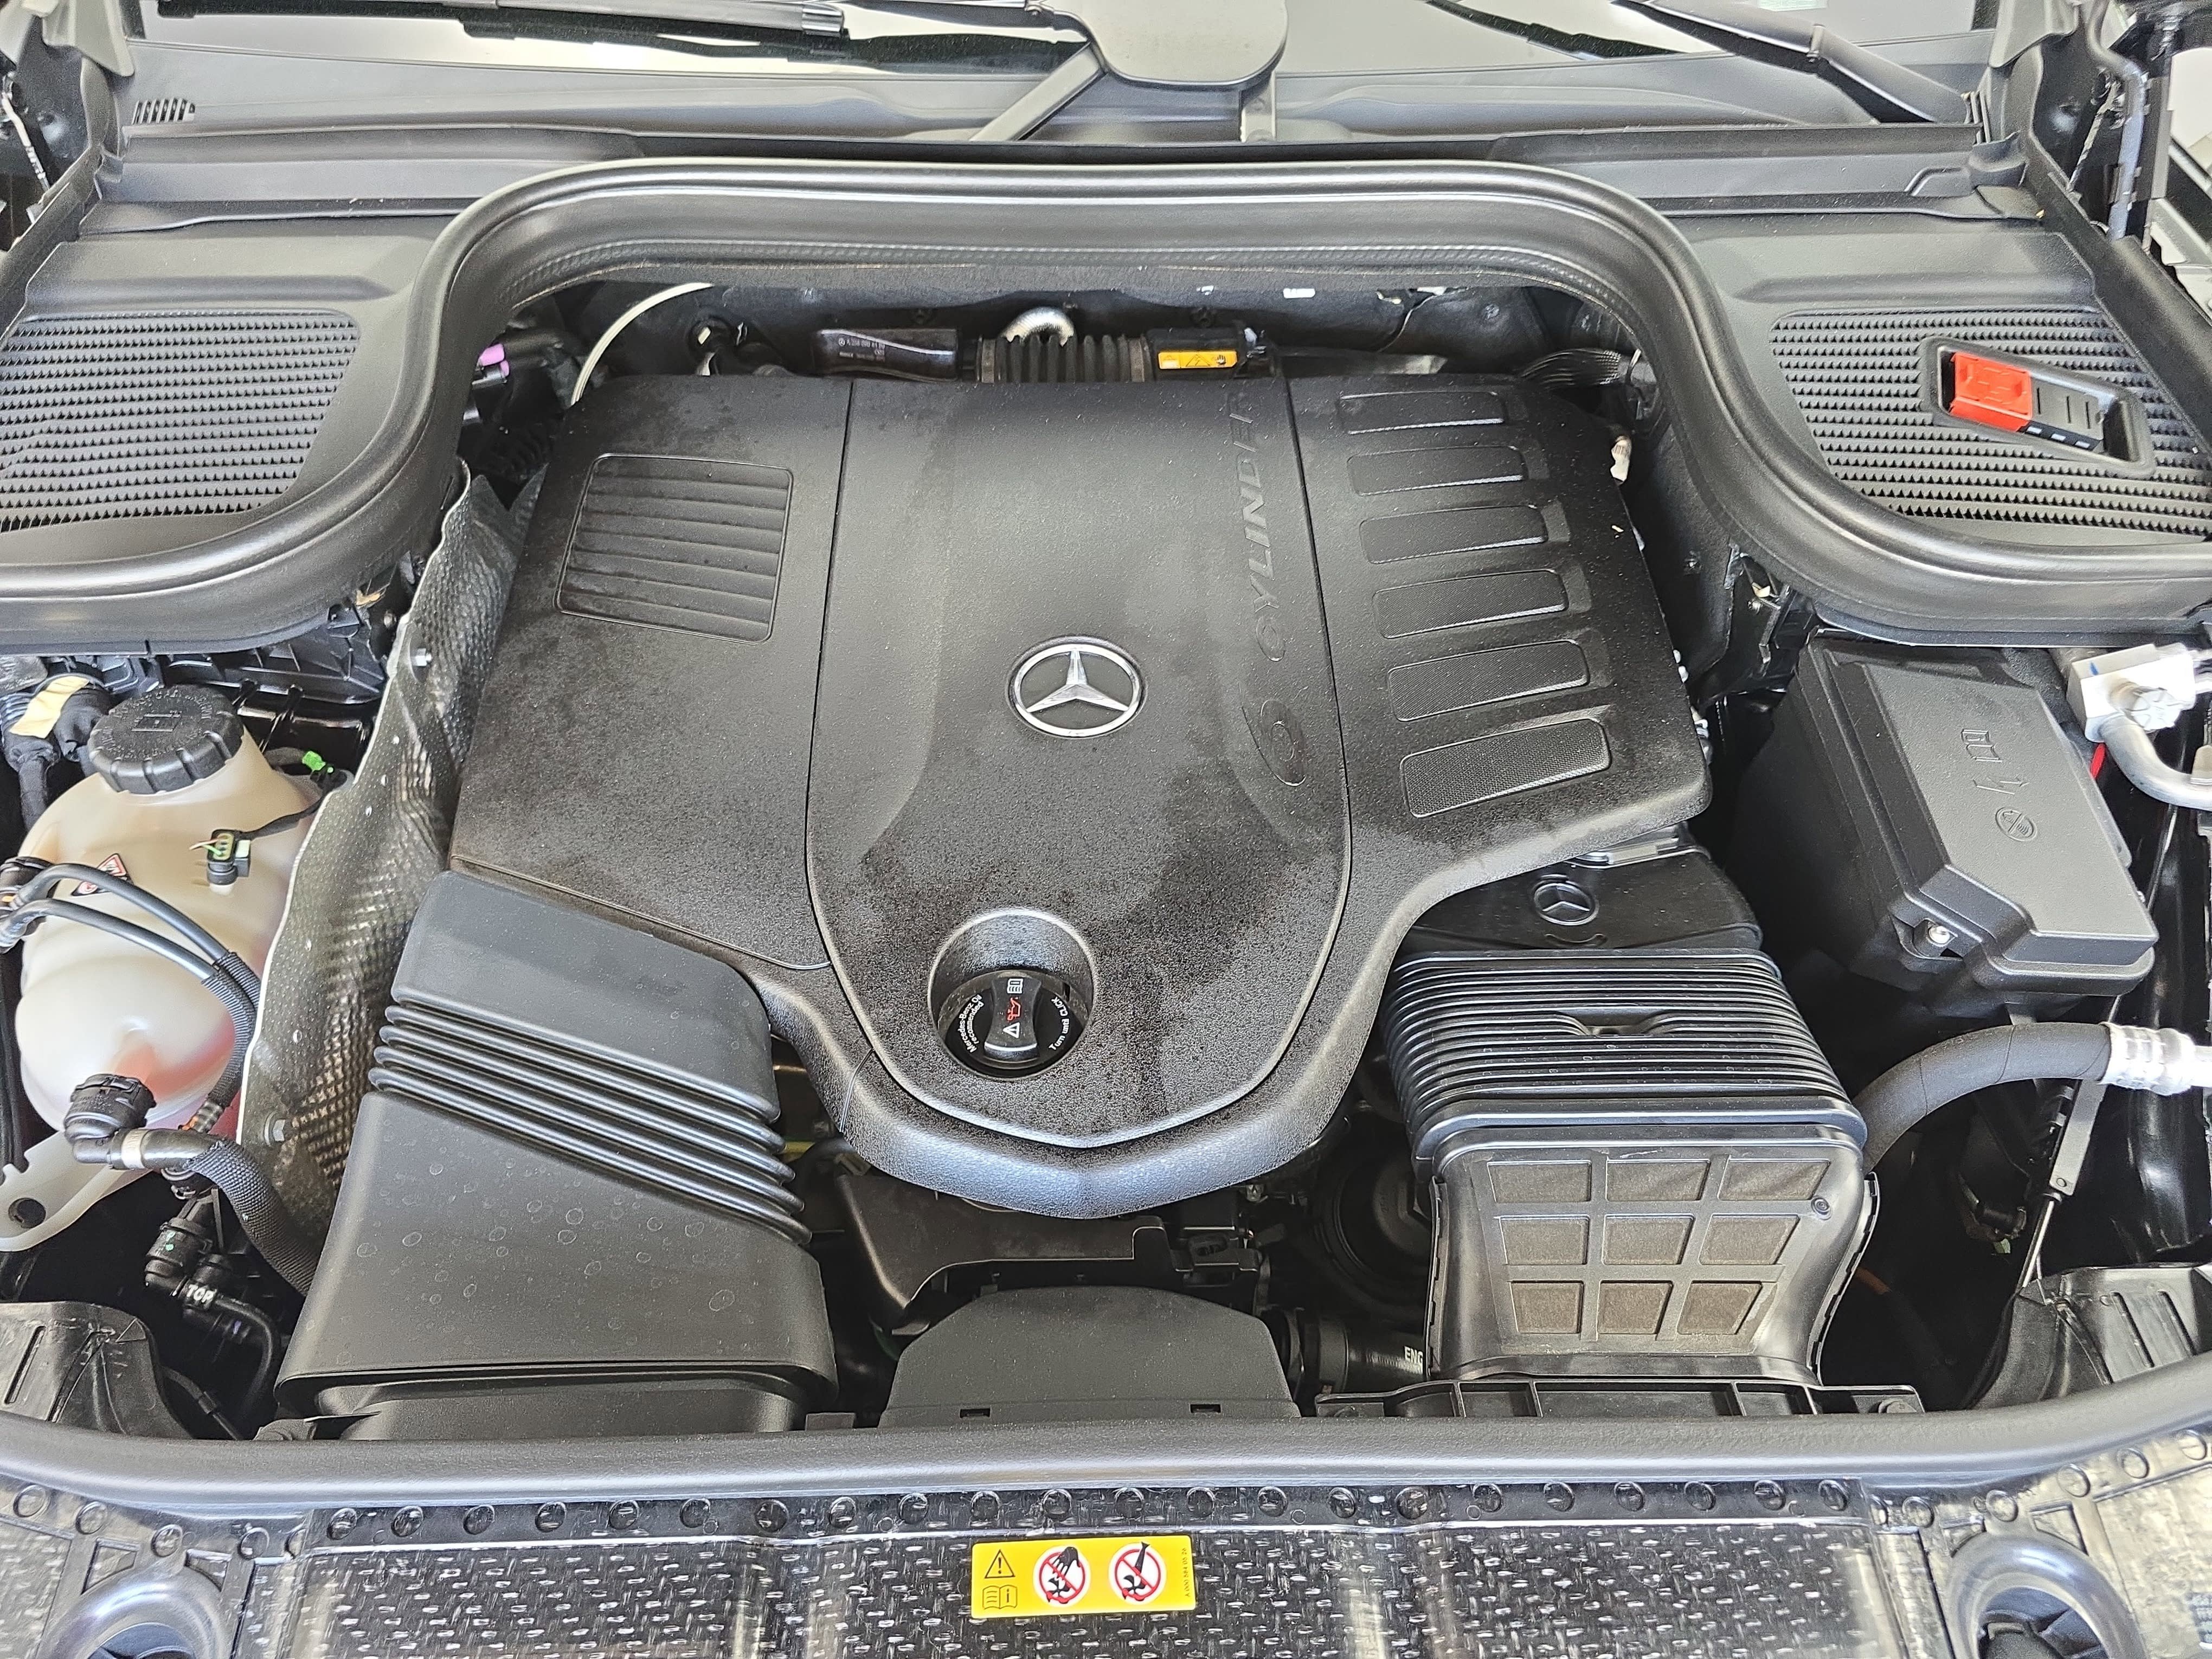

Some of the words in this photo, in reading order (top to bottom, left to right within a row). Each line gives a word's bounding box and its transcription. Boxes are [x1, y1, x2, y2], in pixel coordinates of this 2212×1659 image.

[1051, 995, 1069, 1017] CLICK
[957, 1002, 977, 1053] Mercedes-Benz
[971, 994, 983, 1004] Oil
[967, 1001, 985, 1044] recommended
[1061, 1018, 1070, 1034] until
[1049, 1034, 1066, 1051] Turn
[187, 1284, 214, 1303] TOP
[1404, 1346, 1423, 1365] ENG
